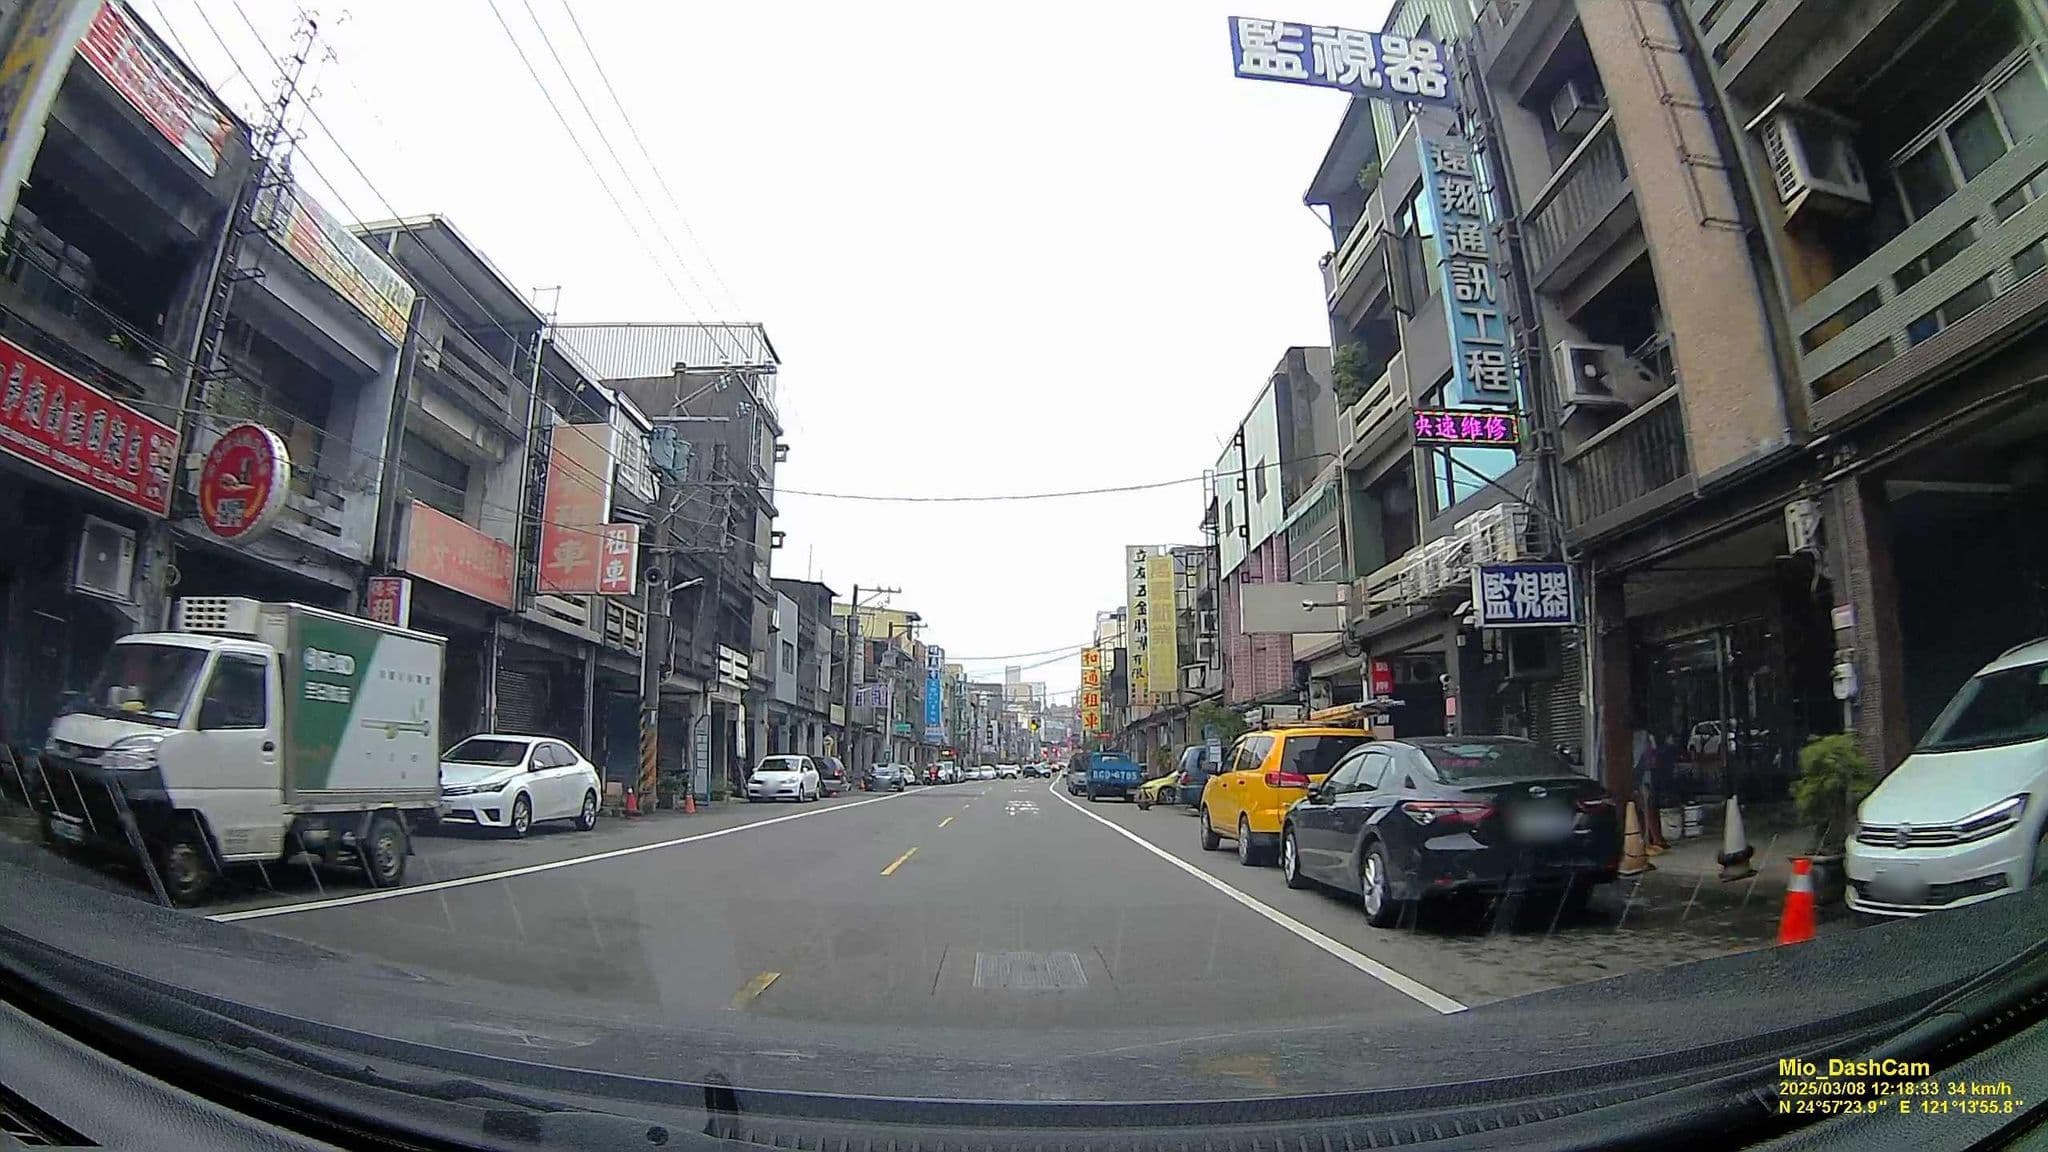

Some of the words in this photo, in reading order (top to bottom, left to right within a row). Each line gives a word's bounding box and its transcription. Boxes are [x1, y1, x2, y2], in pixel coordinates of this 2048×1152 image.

[1237, 18, 1446, 97] 監視器
[1431, 141, 1512, 393] 遠翔通訊工程
[603, 529, 629, 589] 租車
[1482, 572, 1568, 620] 監視器
[1083, 651, 1099, 729] 和通租車
